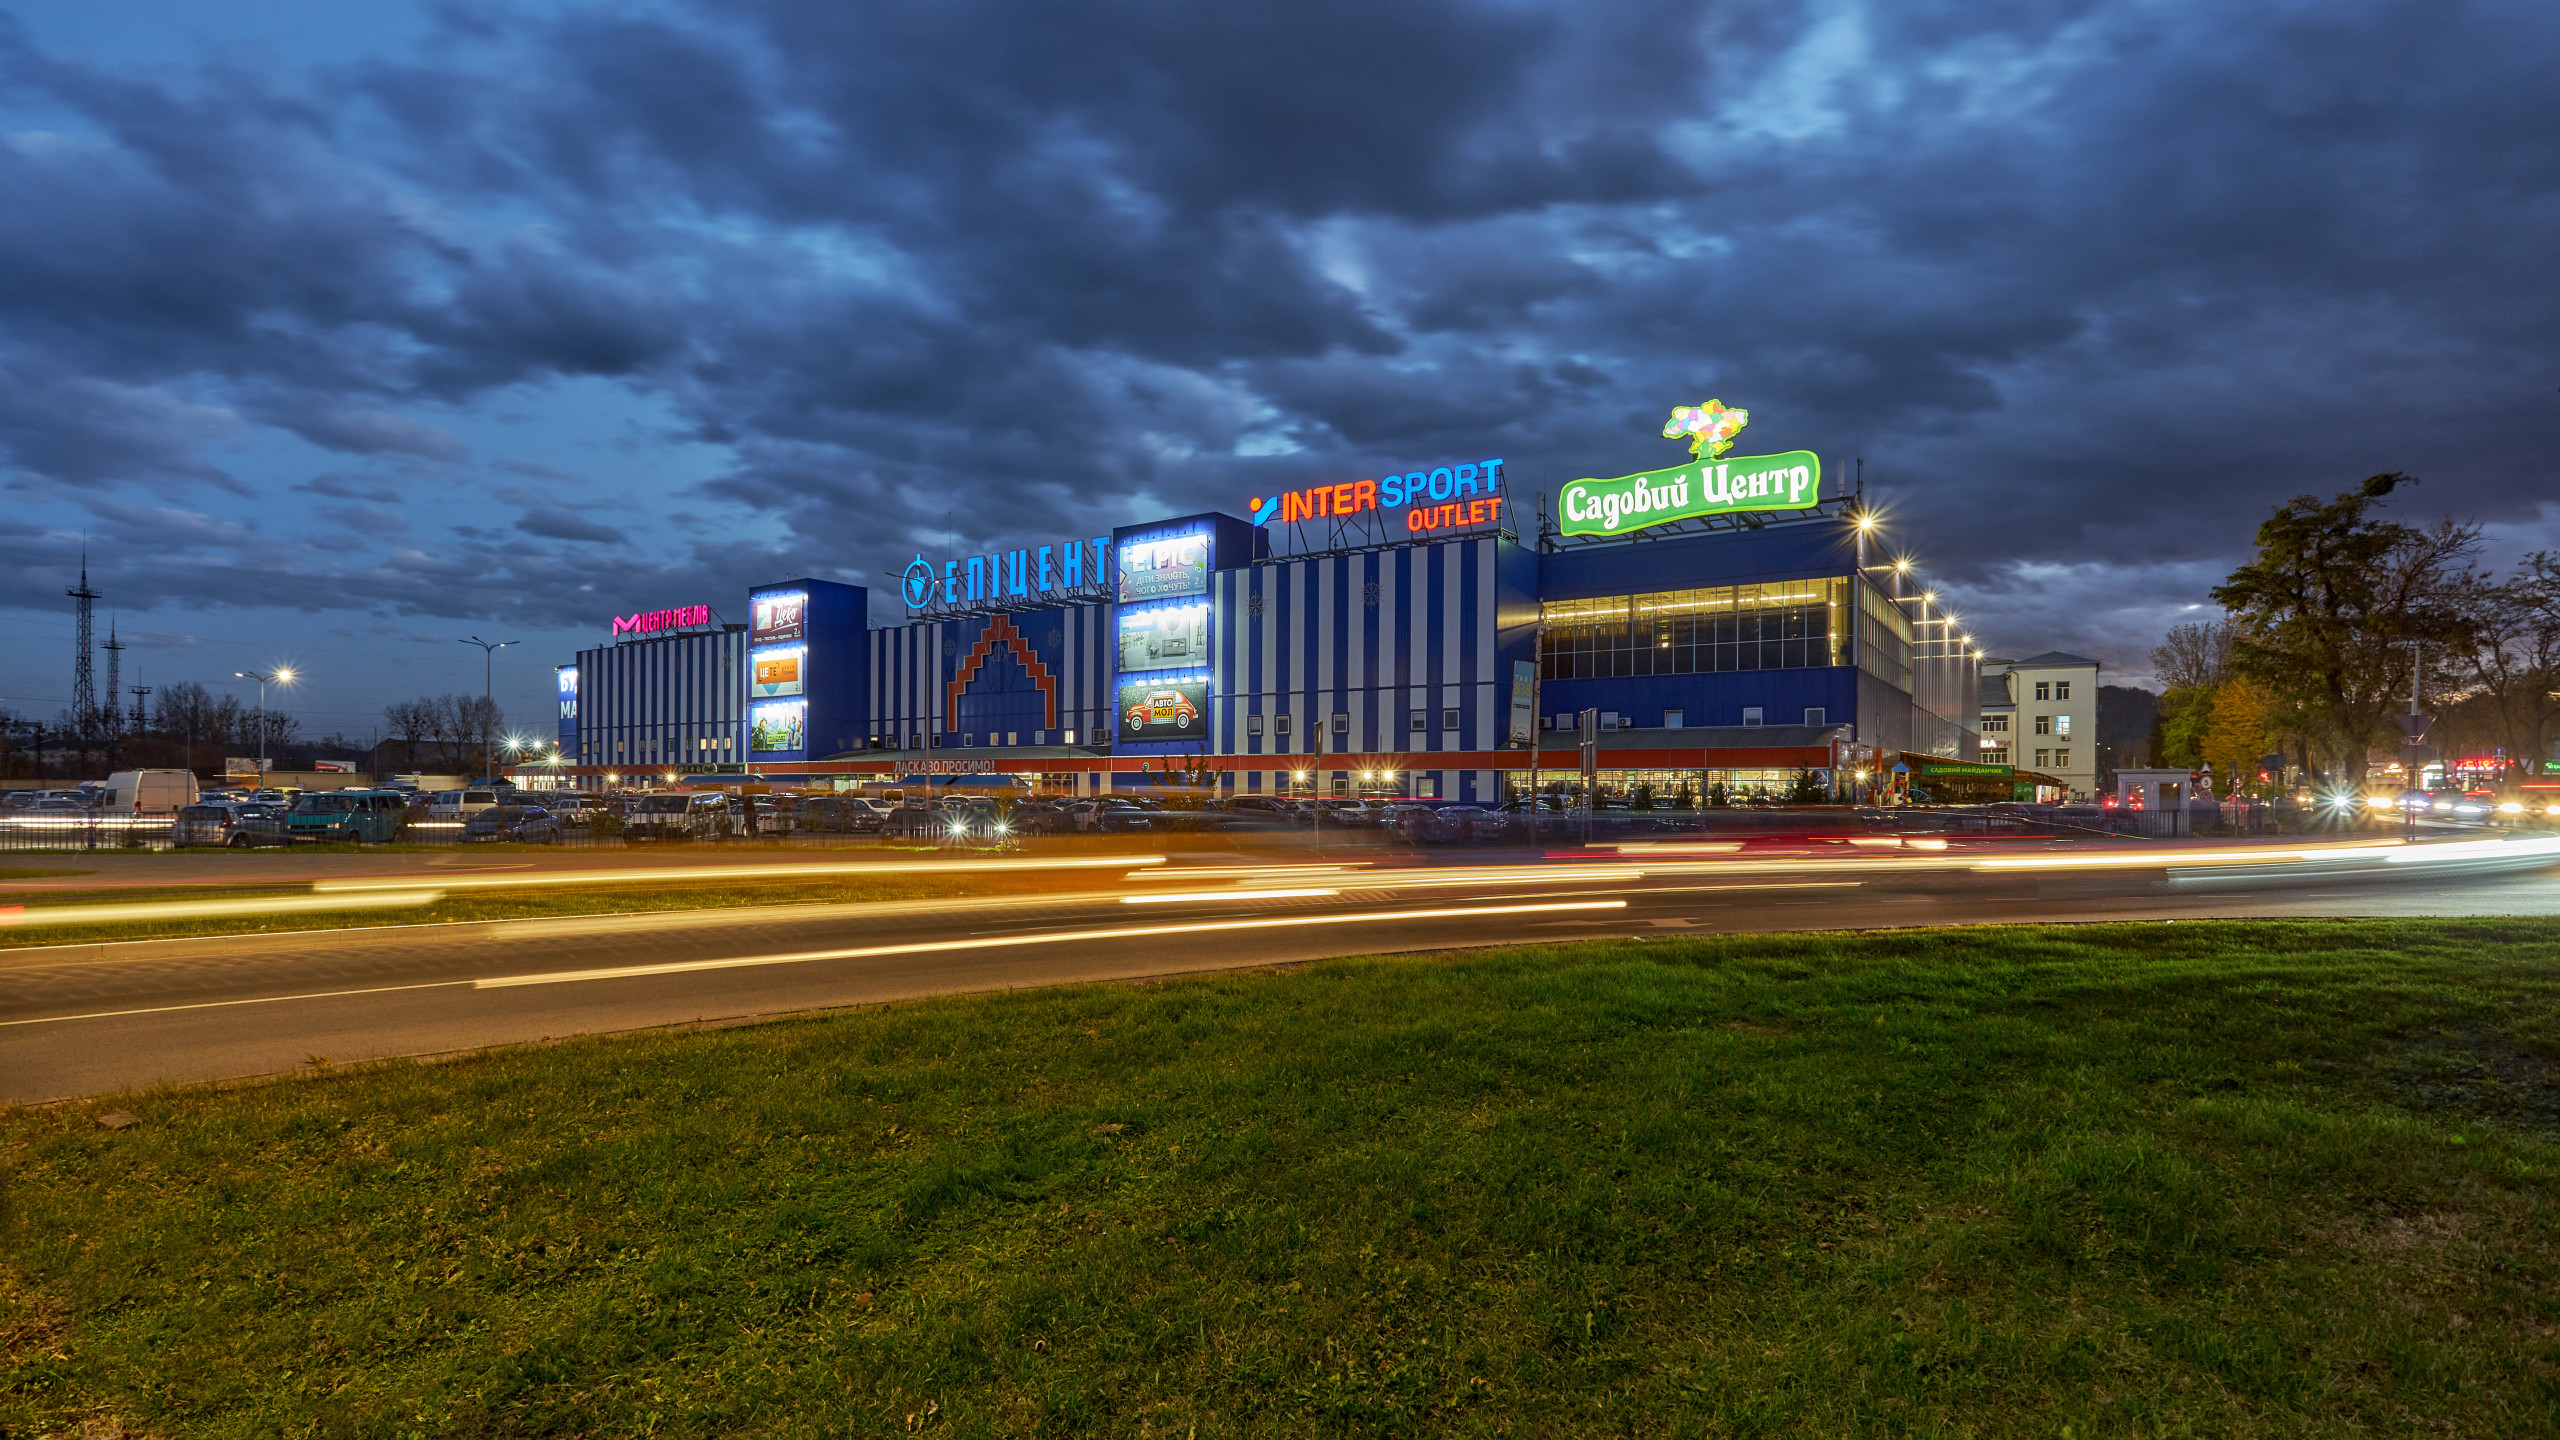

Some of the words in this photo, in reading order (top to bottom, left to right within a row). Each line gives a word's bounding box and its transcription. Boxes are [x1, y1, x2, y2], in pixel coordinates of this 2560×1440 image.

[1282, 458, 1503, 522] INTERSPORT
[1566, 474, 1689, 530] Садовий
[1702, 464, 1809, 506] Центр
[1408, 498, 1502, 532] OUTLET
[1136, 575, 1154, 586] ДІТИ
[1155, 571, 1190, 583] ЗНАЮТЬ,
[1135, 585, 1156, 595] ЧОГО
[1157, 582, 1190, 593] ХОЧУТЬ!
[642, 609, 673, 633] ЦЕНТР
[673, 604, 709, 628] МЕБЛІВ
[1514, 682, 1532, 696] 838
[1154, 699, 1173, 708] АВТО
[1154, 708, 1173, 717] МОЛ
[942, 760, 996, 773] ПРОСИМО!
[1930, 766, 1961, 774] САДОВИЙ
